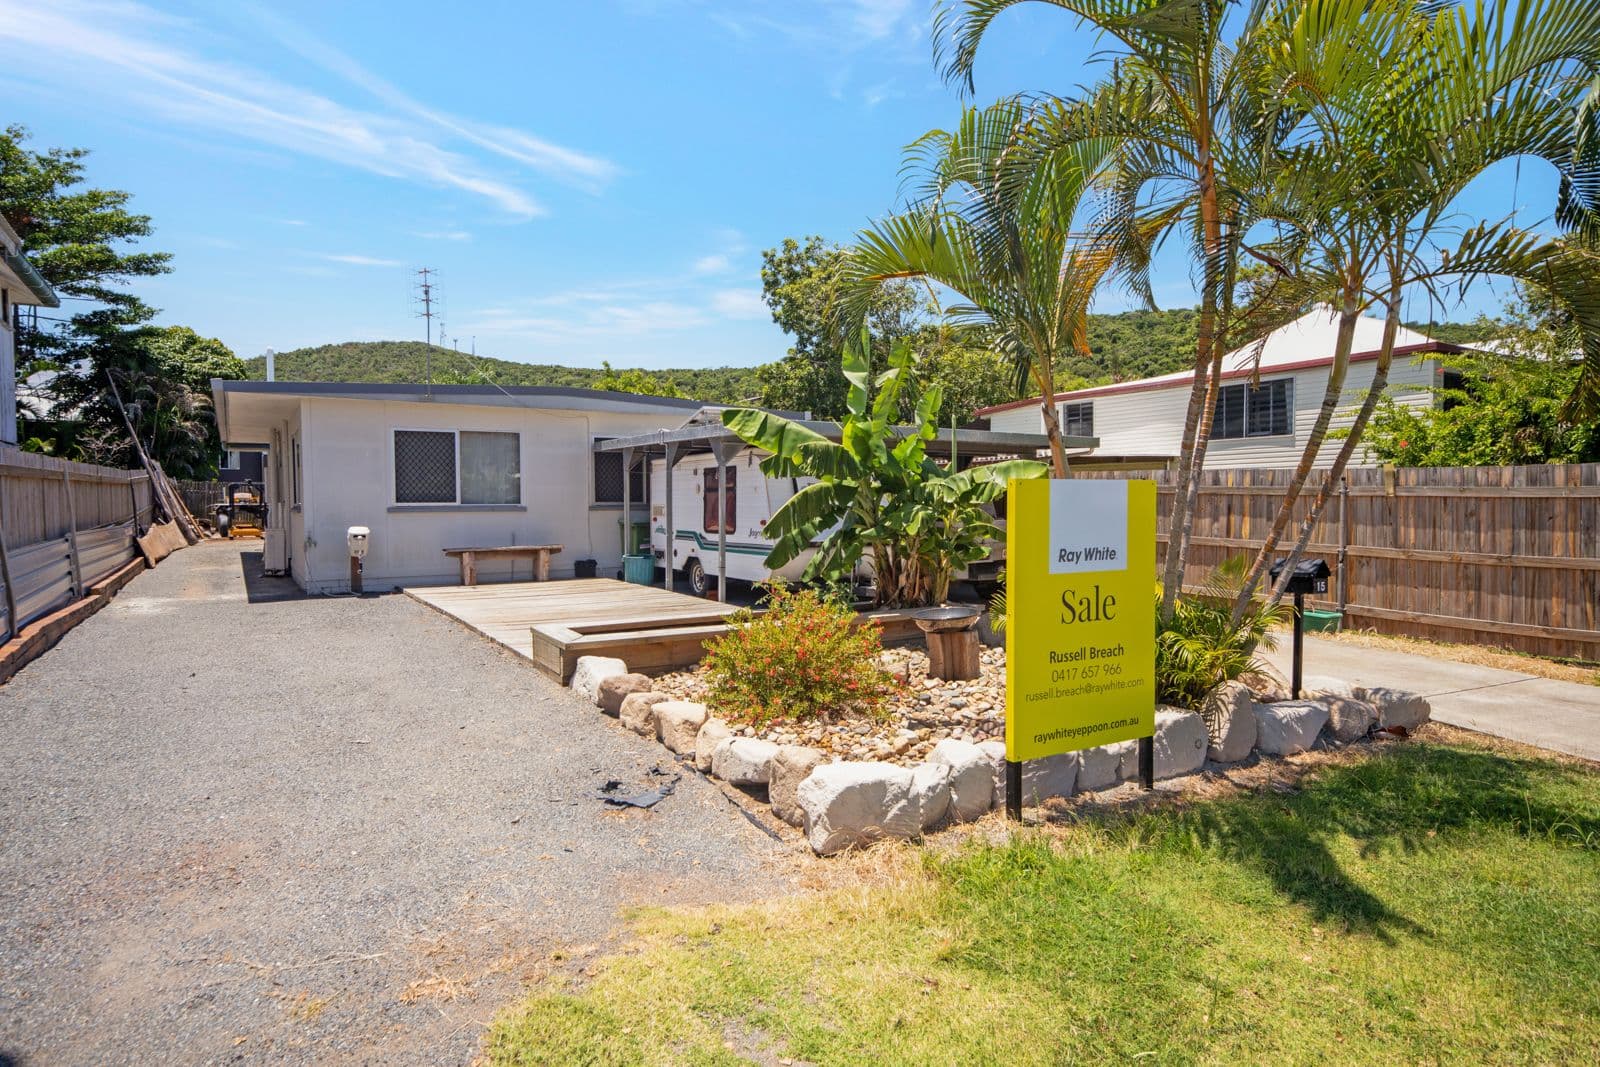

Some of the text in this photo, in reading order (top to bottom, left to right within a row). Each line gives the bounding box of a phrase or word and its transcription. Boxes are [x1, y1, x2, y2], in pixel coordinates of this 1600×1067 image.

[1058, 547, 1117, 564] Ray White
[1317, 581, 1326, 592] 15
[1061, 585, 1116, 625] Sale
[1050, 643, 1124, 664] Russell Breach
[1051, 664, 1122, 683] 0417 657 966
[1025, 678, 1144, 702] russell.breach@raywhite.com
[1034, 717, 1139, 743] raywhiteyeppoon.com.au
